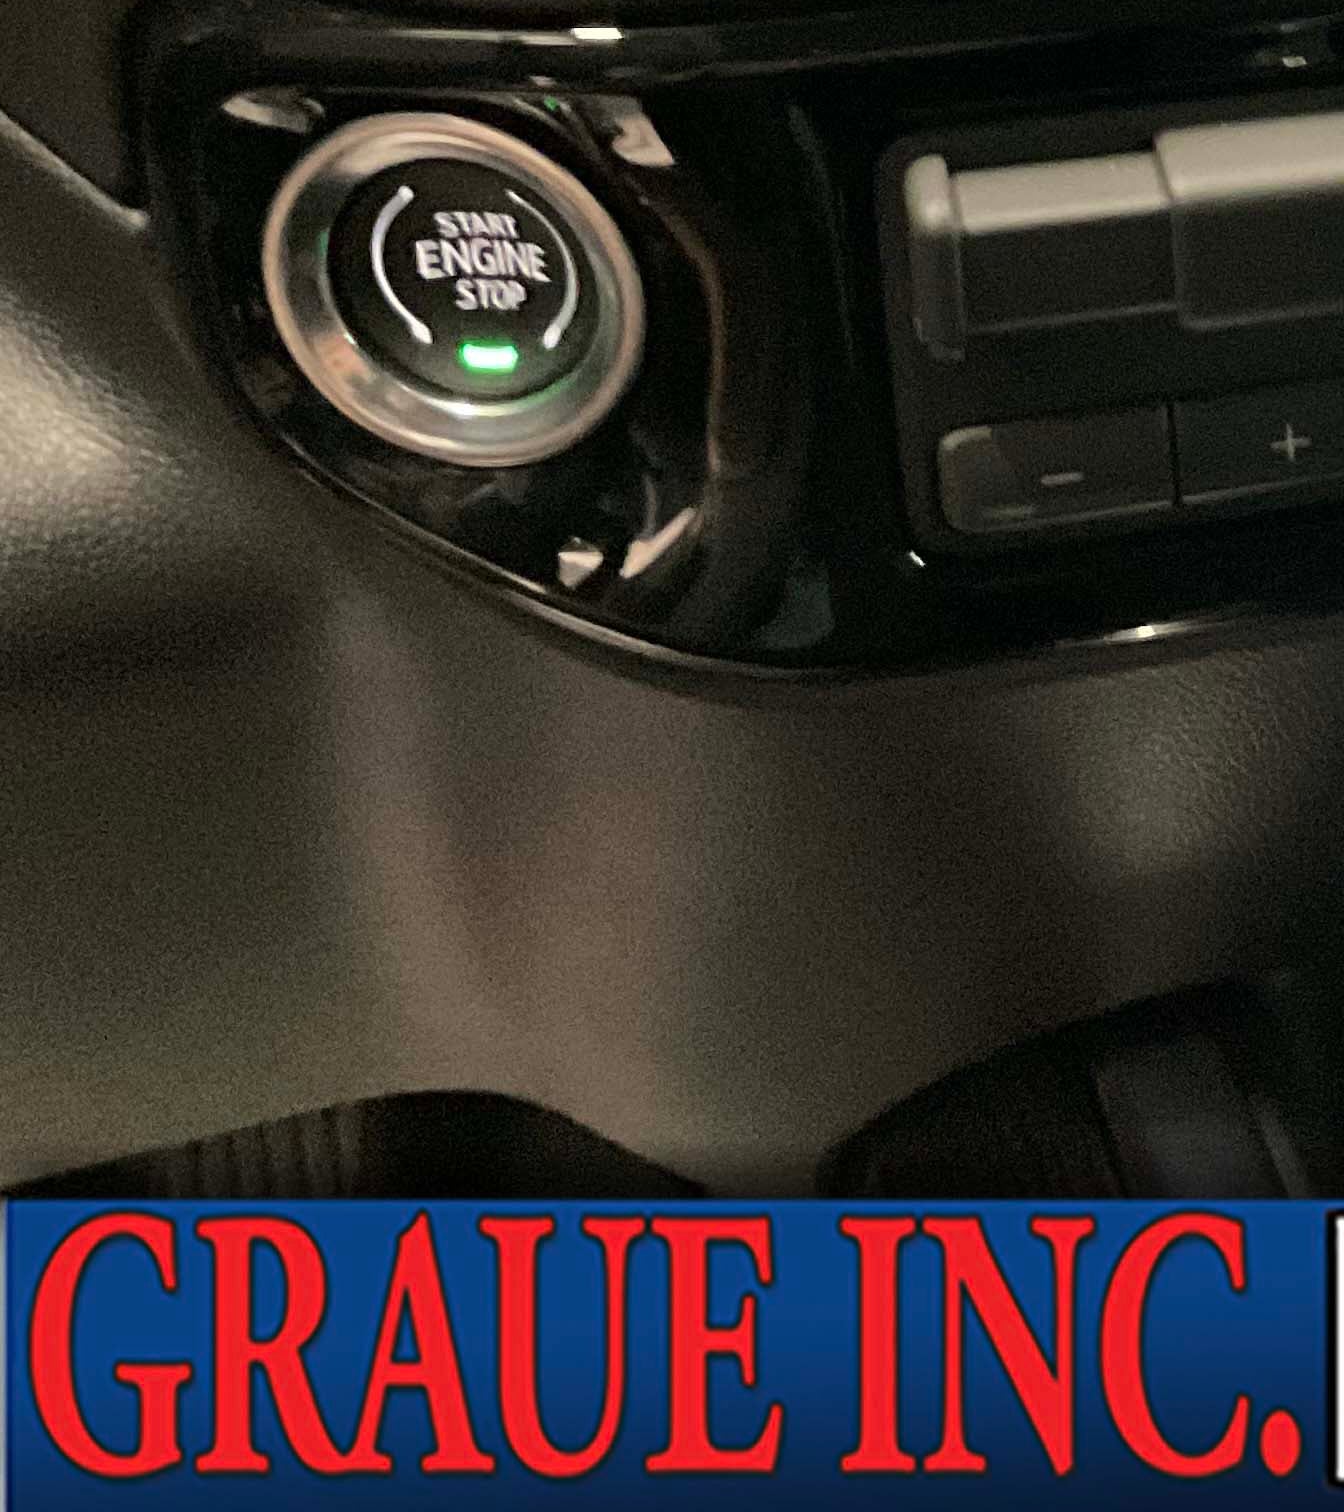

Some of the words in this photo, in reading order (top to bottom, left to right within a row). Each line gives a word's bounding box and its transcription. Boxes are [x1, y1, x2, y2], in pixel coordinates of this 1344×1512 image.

[433, 211, 519, 240] START
[415, 238, 552, 283] ENGINE
[455, 278, 526, 312] STOP
